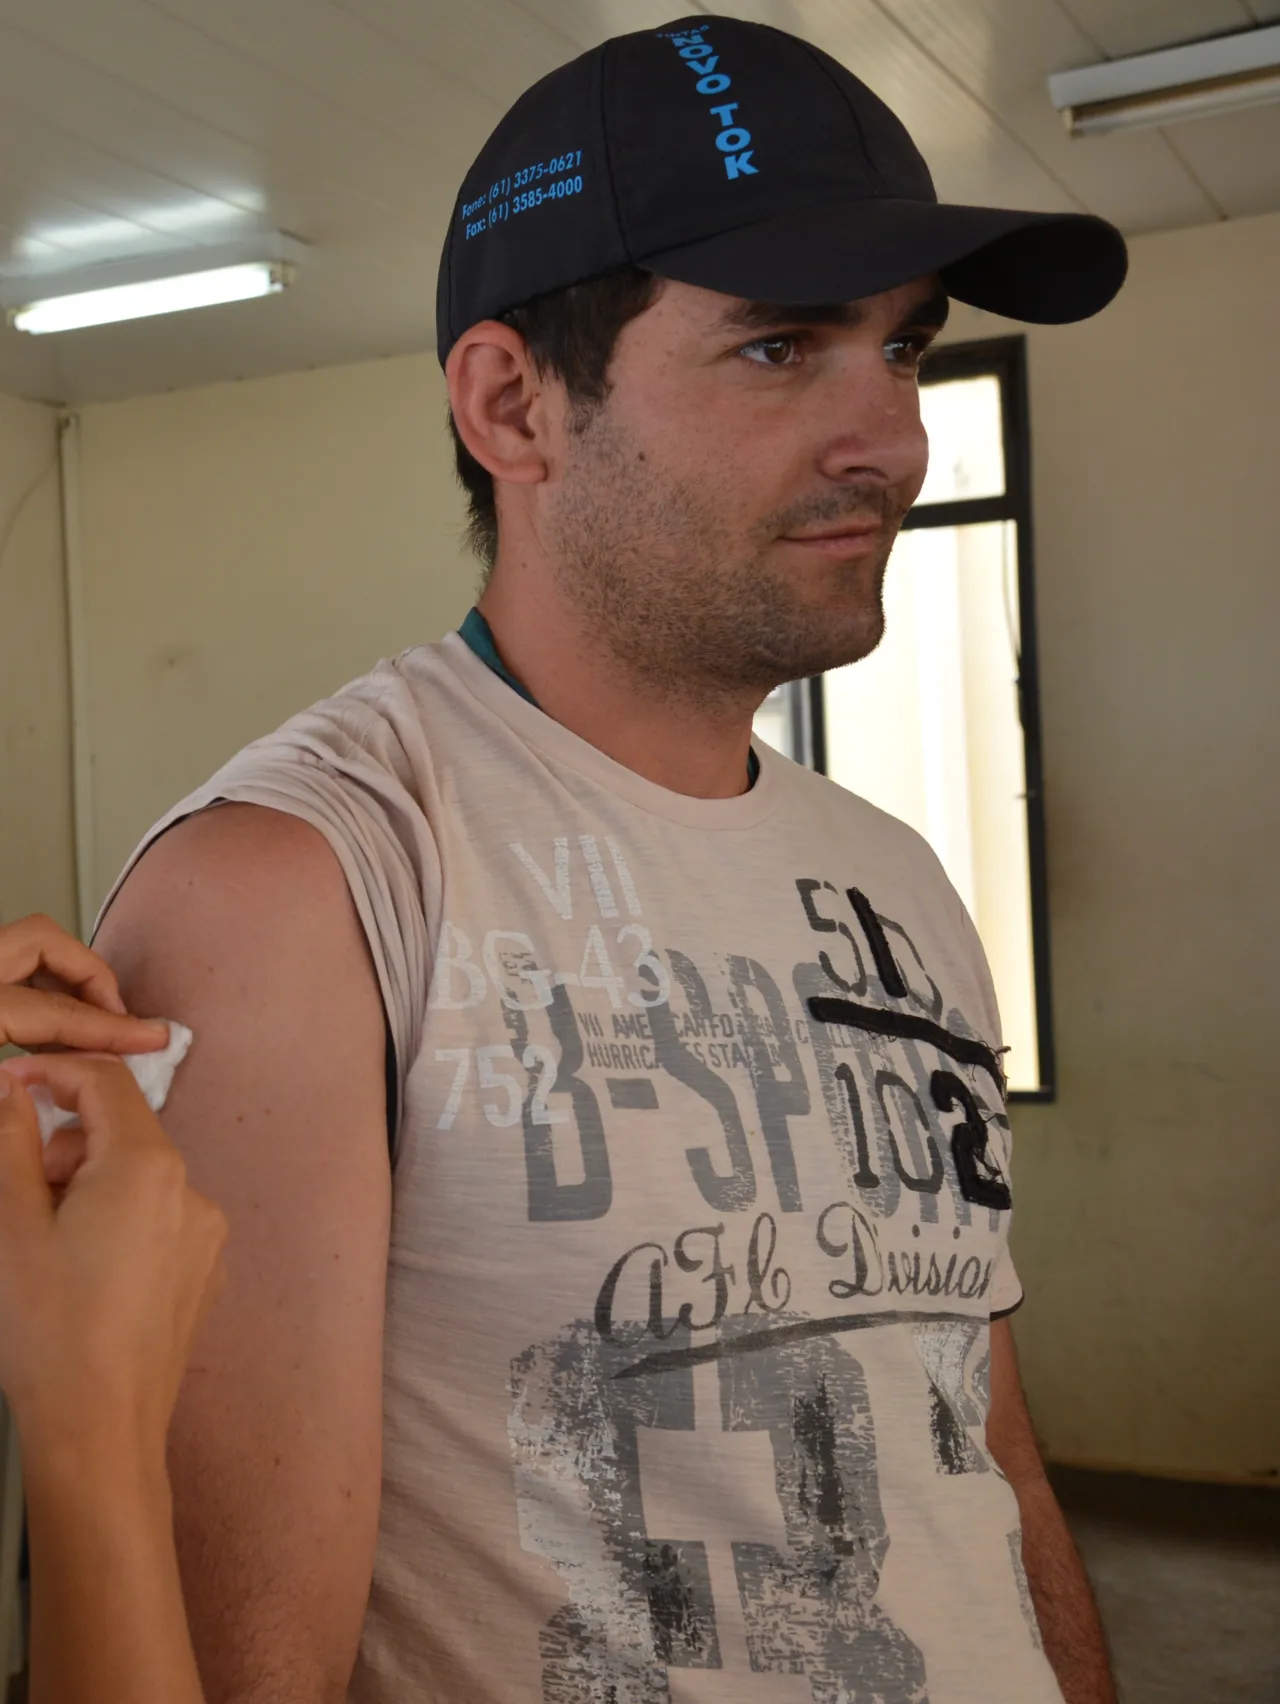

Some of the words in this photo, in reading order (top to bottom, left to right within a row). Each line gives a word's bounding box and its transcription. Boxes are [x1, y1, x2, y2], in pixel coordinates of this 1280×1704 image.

[671, 34, 731, 95] NOVO
[709, 103, 759, 180] TOK
[461, 193, 487, 220] Fone:
[488, 176, 511, 205] (61)
[513, 150, 583, 188] 3375-0621
[465, 218, 487, 240] Fax:
[488, 201, 510, 229] (61)
[512, 175, 583, 214] 3585-4000
[508, 834, 643, 920] VII
[428, 919, 671, 1011] BG-43
[577, 1012, 605, 1037] VII
[434, 1043, 570, 1131] 752
[834, 1062, 1013, 1210] 102
